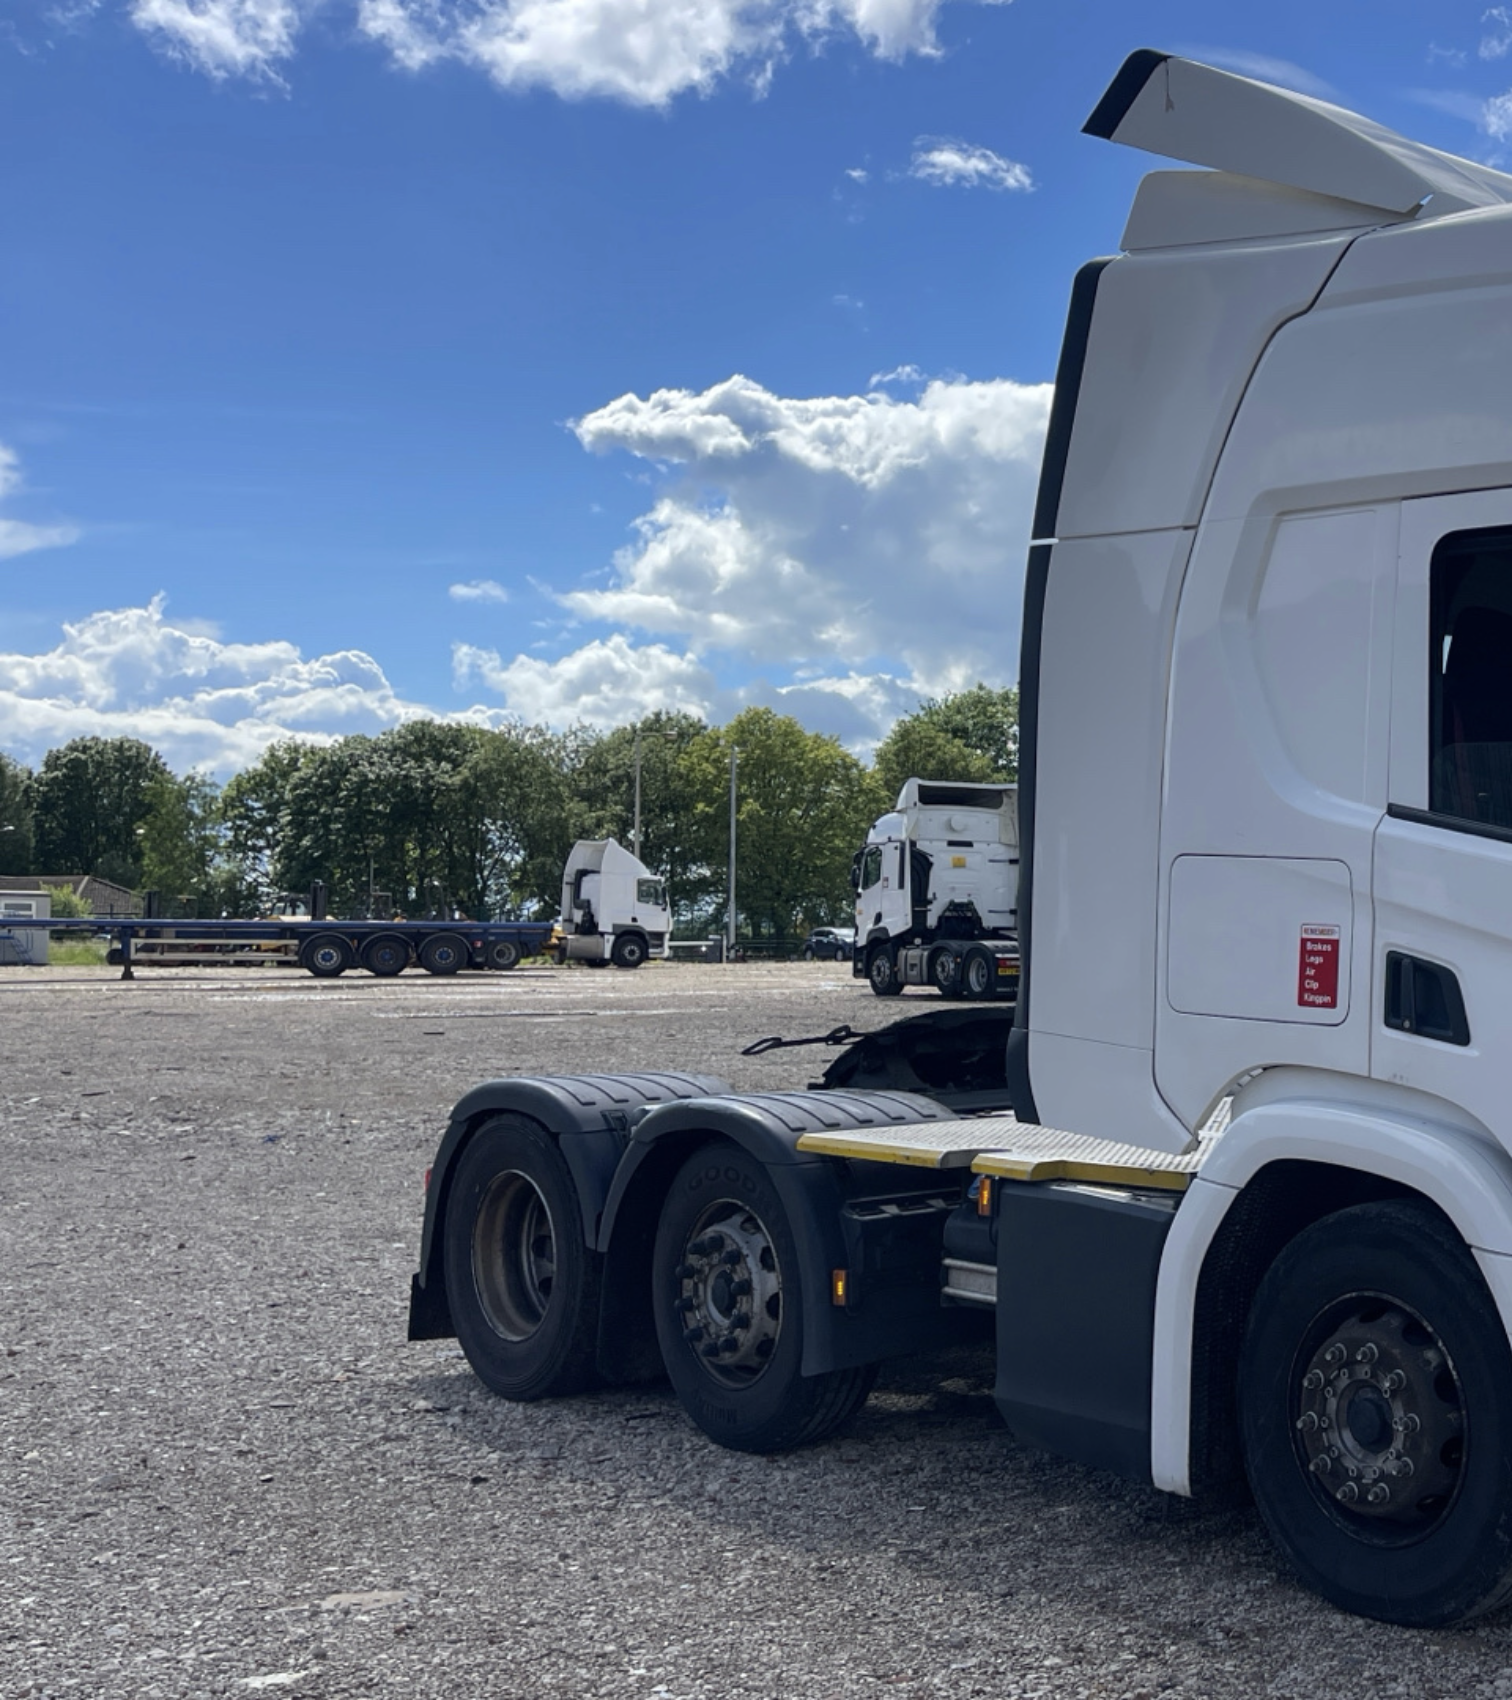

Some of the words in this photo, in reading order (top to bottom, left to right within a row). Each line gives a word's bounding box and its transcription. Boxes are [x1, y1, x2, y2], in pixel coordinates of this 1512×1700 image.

[1306, 941, 1331, 951] Brakes
[1305, 954, 1323, 964] Legs
[1305, 967, 1316, 976] Air
[1304, 979, 1319, 990] Clip
[1304, 993, 1331, 1004] Kingpin
